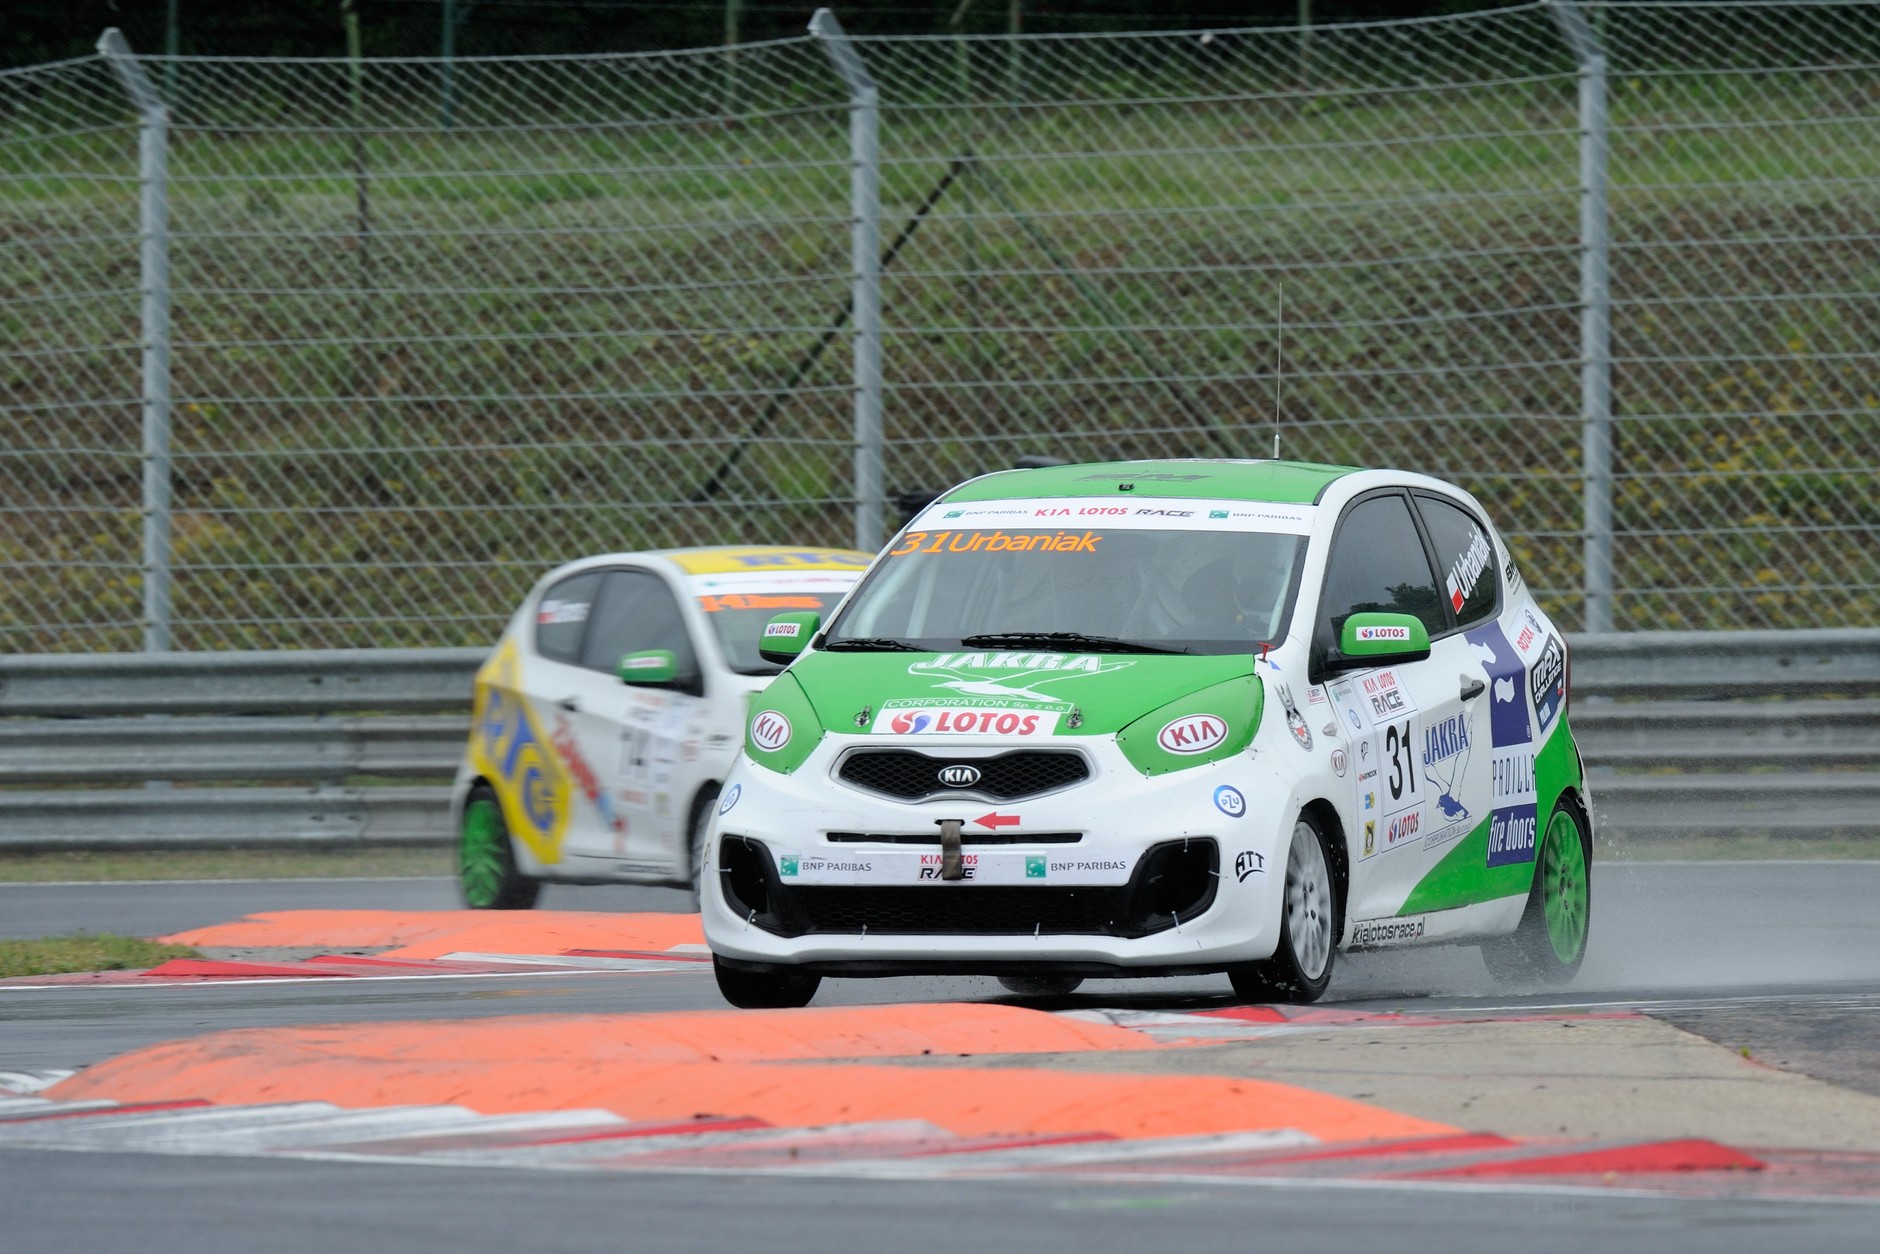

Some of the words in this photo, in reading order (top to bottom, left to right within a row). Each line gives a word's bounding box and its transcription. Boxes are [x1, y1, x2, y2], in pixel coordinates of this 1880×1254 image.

[1034, 508, 1070, 517] KIA
[1078, 507, 1128, 516] LOTOS
[1135, 508, 1195, 518] RACE
[1453, 522, 1491, 600] Urbaniak
[775, 624, 796, 634] LOTOS
[1375, 628, 1405, 638] LOTOS
[1517, 624, 1535, 653] ROTAX
[921, 652, 1102, 673] JAKRA
[1533, 639, 1561, 693] MAX
[1362, 678, 1378, 694] KIA
[1378, 671, 1396, 689] LOTOS
[1534, 662, 1562, 704] CHALLENGE
[888, 699, 1009, 708] CORPORATION
[1371, 689, 1404, 715] RACE
[756, 715, 784, 745] KIA
[936, 712, 1040, 736] LOTOS
[1170, 720, 1219, 747] KIA
[1423, 712, 1469, 766] JAKRA
[1386, 720, 1415, 801] 31
[944, 768, 973, 783] KIA
[1492, 753, 1537, 798] PADILLA
[1397, 811, 1420, 839] LOTOS
[1487, 815, 1505, 861] fire
[1506, 812, 1536, 851] doors
[802, 862, 825, 872] BNP
[826, 862, 873, 873] PARIBAS
[920, 854, 943, 865] KIA
[1050, 861, 1075, 872] BNP
[1077, 859, 1126, 871] PARIBAS
[1235, 851, 1265, 878] ATT
